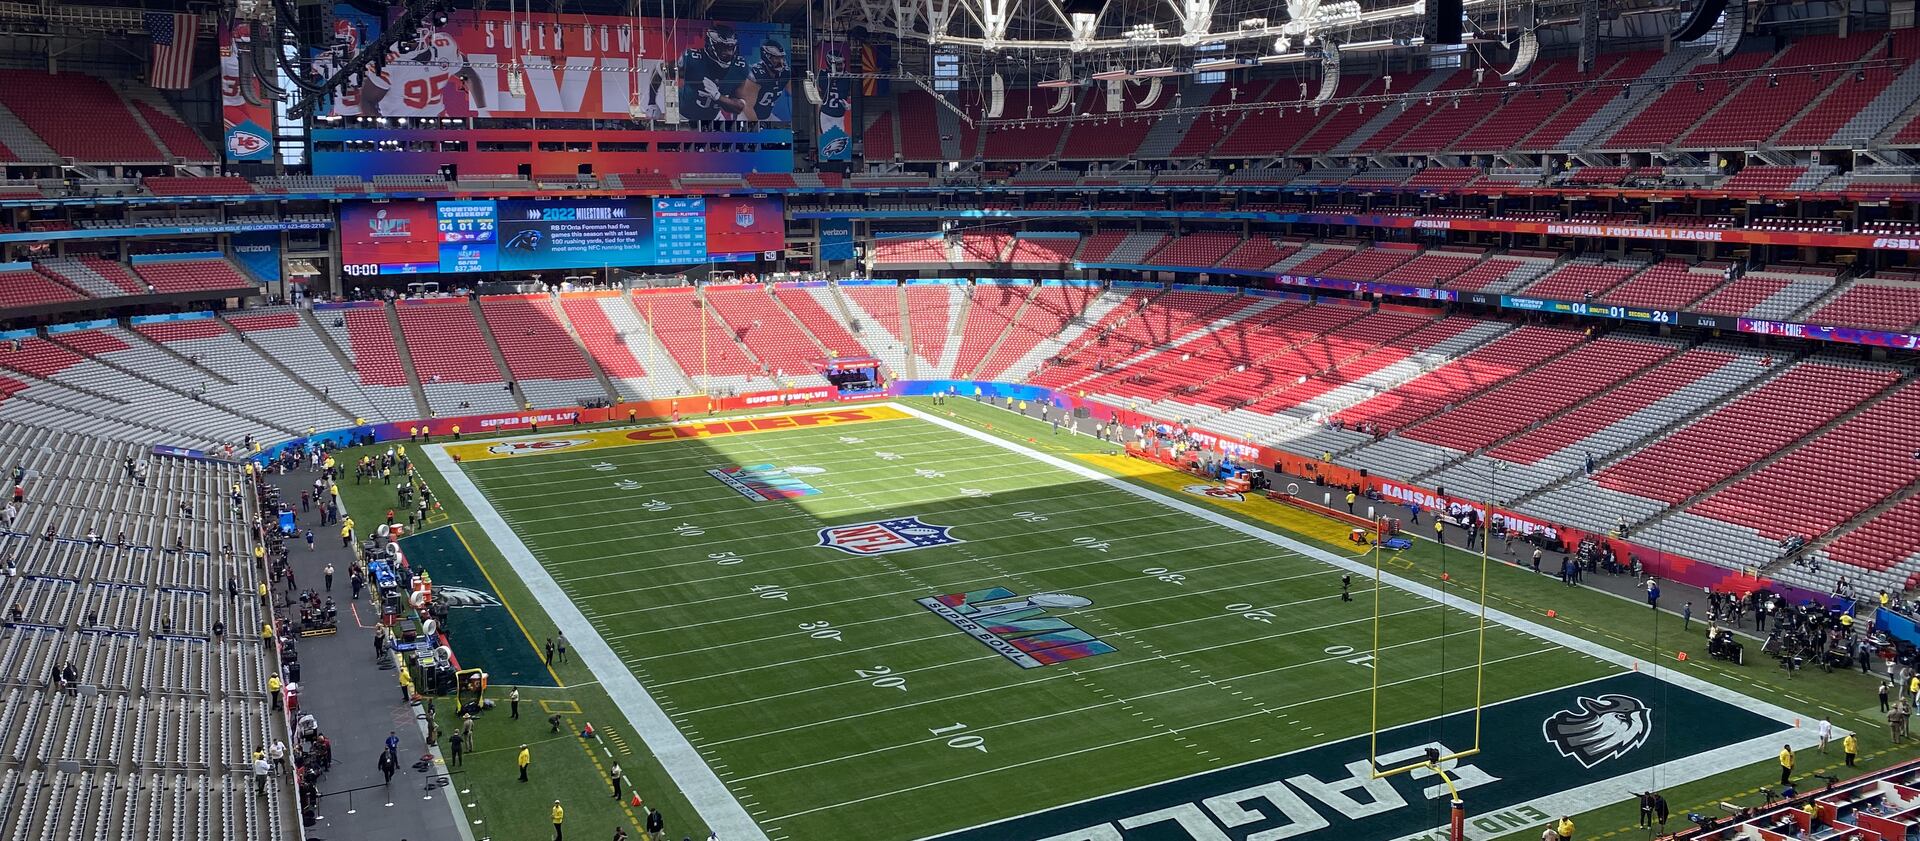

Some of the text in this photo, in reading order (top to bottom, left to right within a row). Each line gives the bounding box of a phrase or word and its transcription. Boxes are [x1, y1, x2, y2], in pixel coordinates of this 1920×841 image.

[486, 20, 647, 53] SUPER BOWL
[543, 207, 612, 221] 2022 MILESTONES
[439, 222, 494, 231] 04 01 26
[822, 228, 848, 236] verizon
[1414, 219, 1450, 229] #SBLVII
[1547, 224, 1723, 241] NATIONAL FOOTBALL LEAGUE
[235, 243, 271, 253] verizon
[1873, 238, 1920, 250] #SBL
[343, 263, 378, 276] 90:00
[1572, 303, 1586, 315] 04
[1610, 307, 1625, 318] 01
[1653, 311, 1669, 323] 26
[746, 395, 778, 404] SUPER
[480, 417, 519, 427] SUPER
[625, 409, 873, 441] CHIEFS
[1219, 439, 1260, 459] CHIEFS
[1382, 483, 1447, 510] KANSAS
[832, 524, 907, 552] NFL
[708, 551, 744, 566] 50
[750, 584, 788, 599] 40
[798, 620, 842, 639] 30
[928, 602, 1027, 661] SUPER BOWL
[854, 665, 906, 688] 20
[928, 722, 984, 748] 10
[1472, 805, 1551, 834] END
